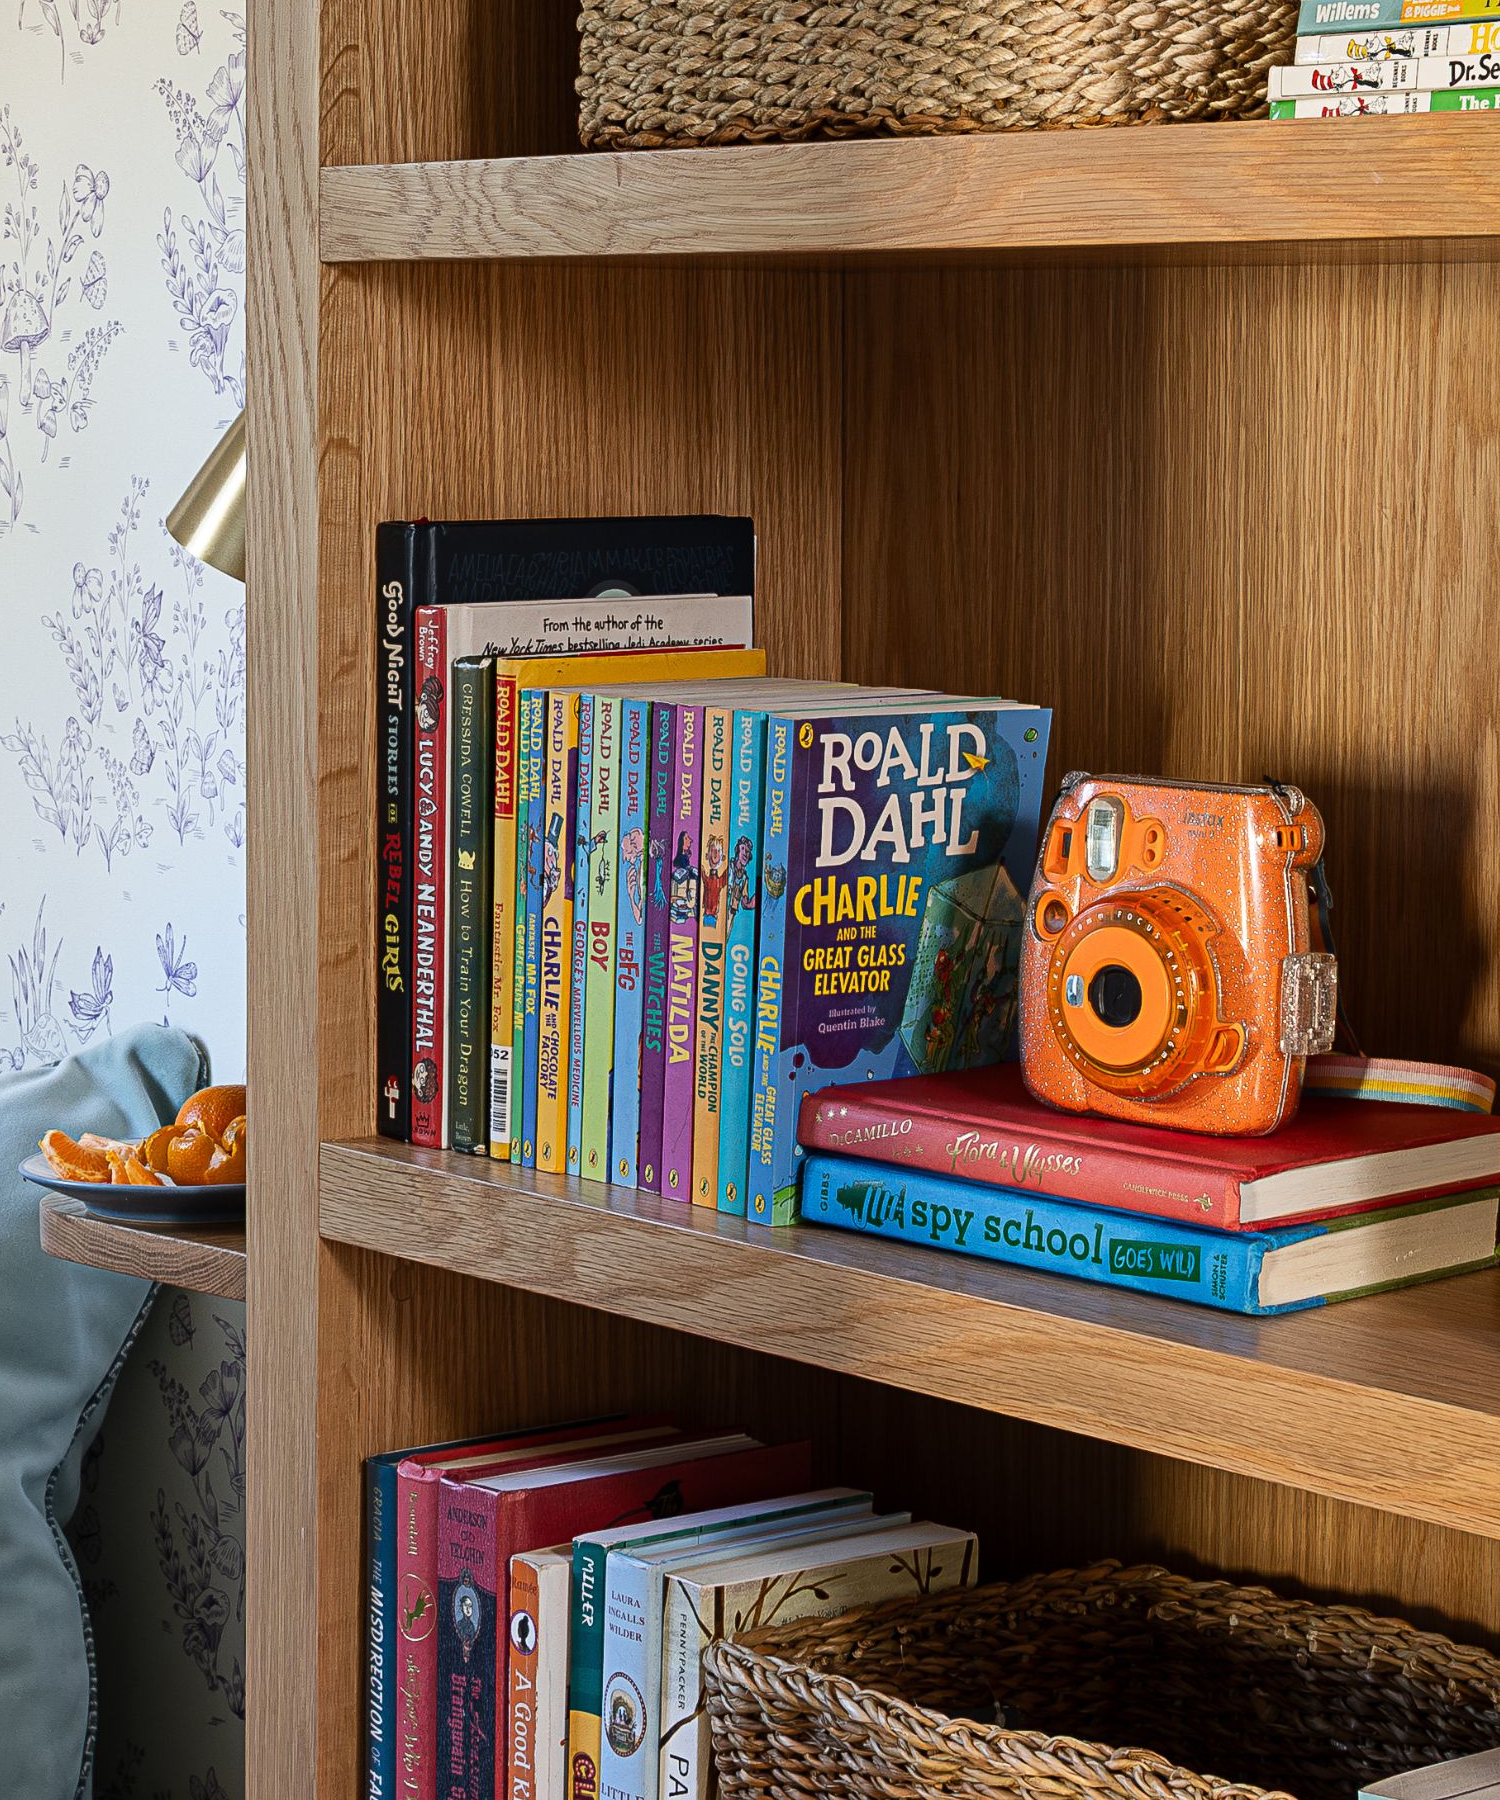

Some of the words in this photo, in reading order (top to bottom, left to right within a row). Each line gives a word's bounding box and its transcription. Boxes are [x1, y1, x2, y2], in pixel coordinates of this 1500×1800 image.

[818, 723, 989, 794] ROALD
[815, 786, 979, 869] DAHL
[794, 874, 923, 926] CHARLIE
[590, 921, 610, 973] BOY
[803, 947, 853, 971] GREAT
[857, 943, 906, 967] GLASS
[837, 927, 856, 941] AND
[860, 926, 876, 939] THE
[669, 935, 694, 1065] MATILDA
[814, 971, 890, 996] ELEVATOR
[818, 1020, 857, 1034] Quentin
[860, 1017, 886, 1028] Blake
[829, 1006, 866, 1018] Illustrated
[868, 1006, 876, 1014] by
[910, 1200, 972, 1245] spy
[982, 1211, 1104, 1265] school
[1113, 1245, 1156, 1273] GOES
[1160, 1251, 1196, 1278] WILD
[580, 1555, 594, 1627] MILLER
[678, 1613, 686, 1710] PENNYPACKER
